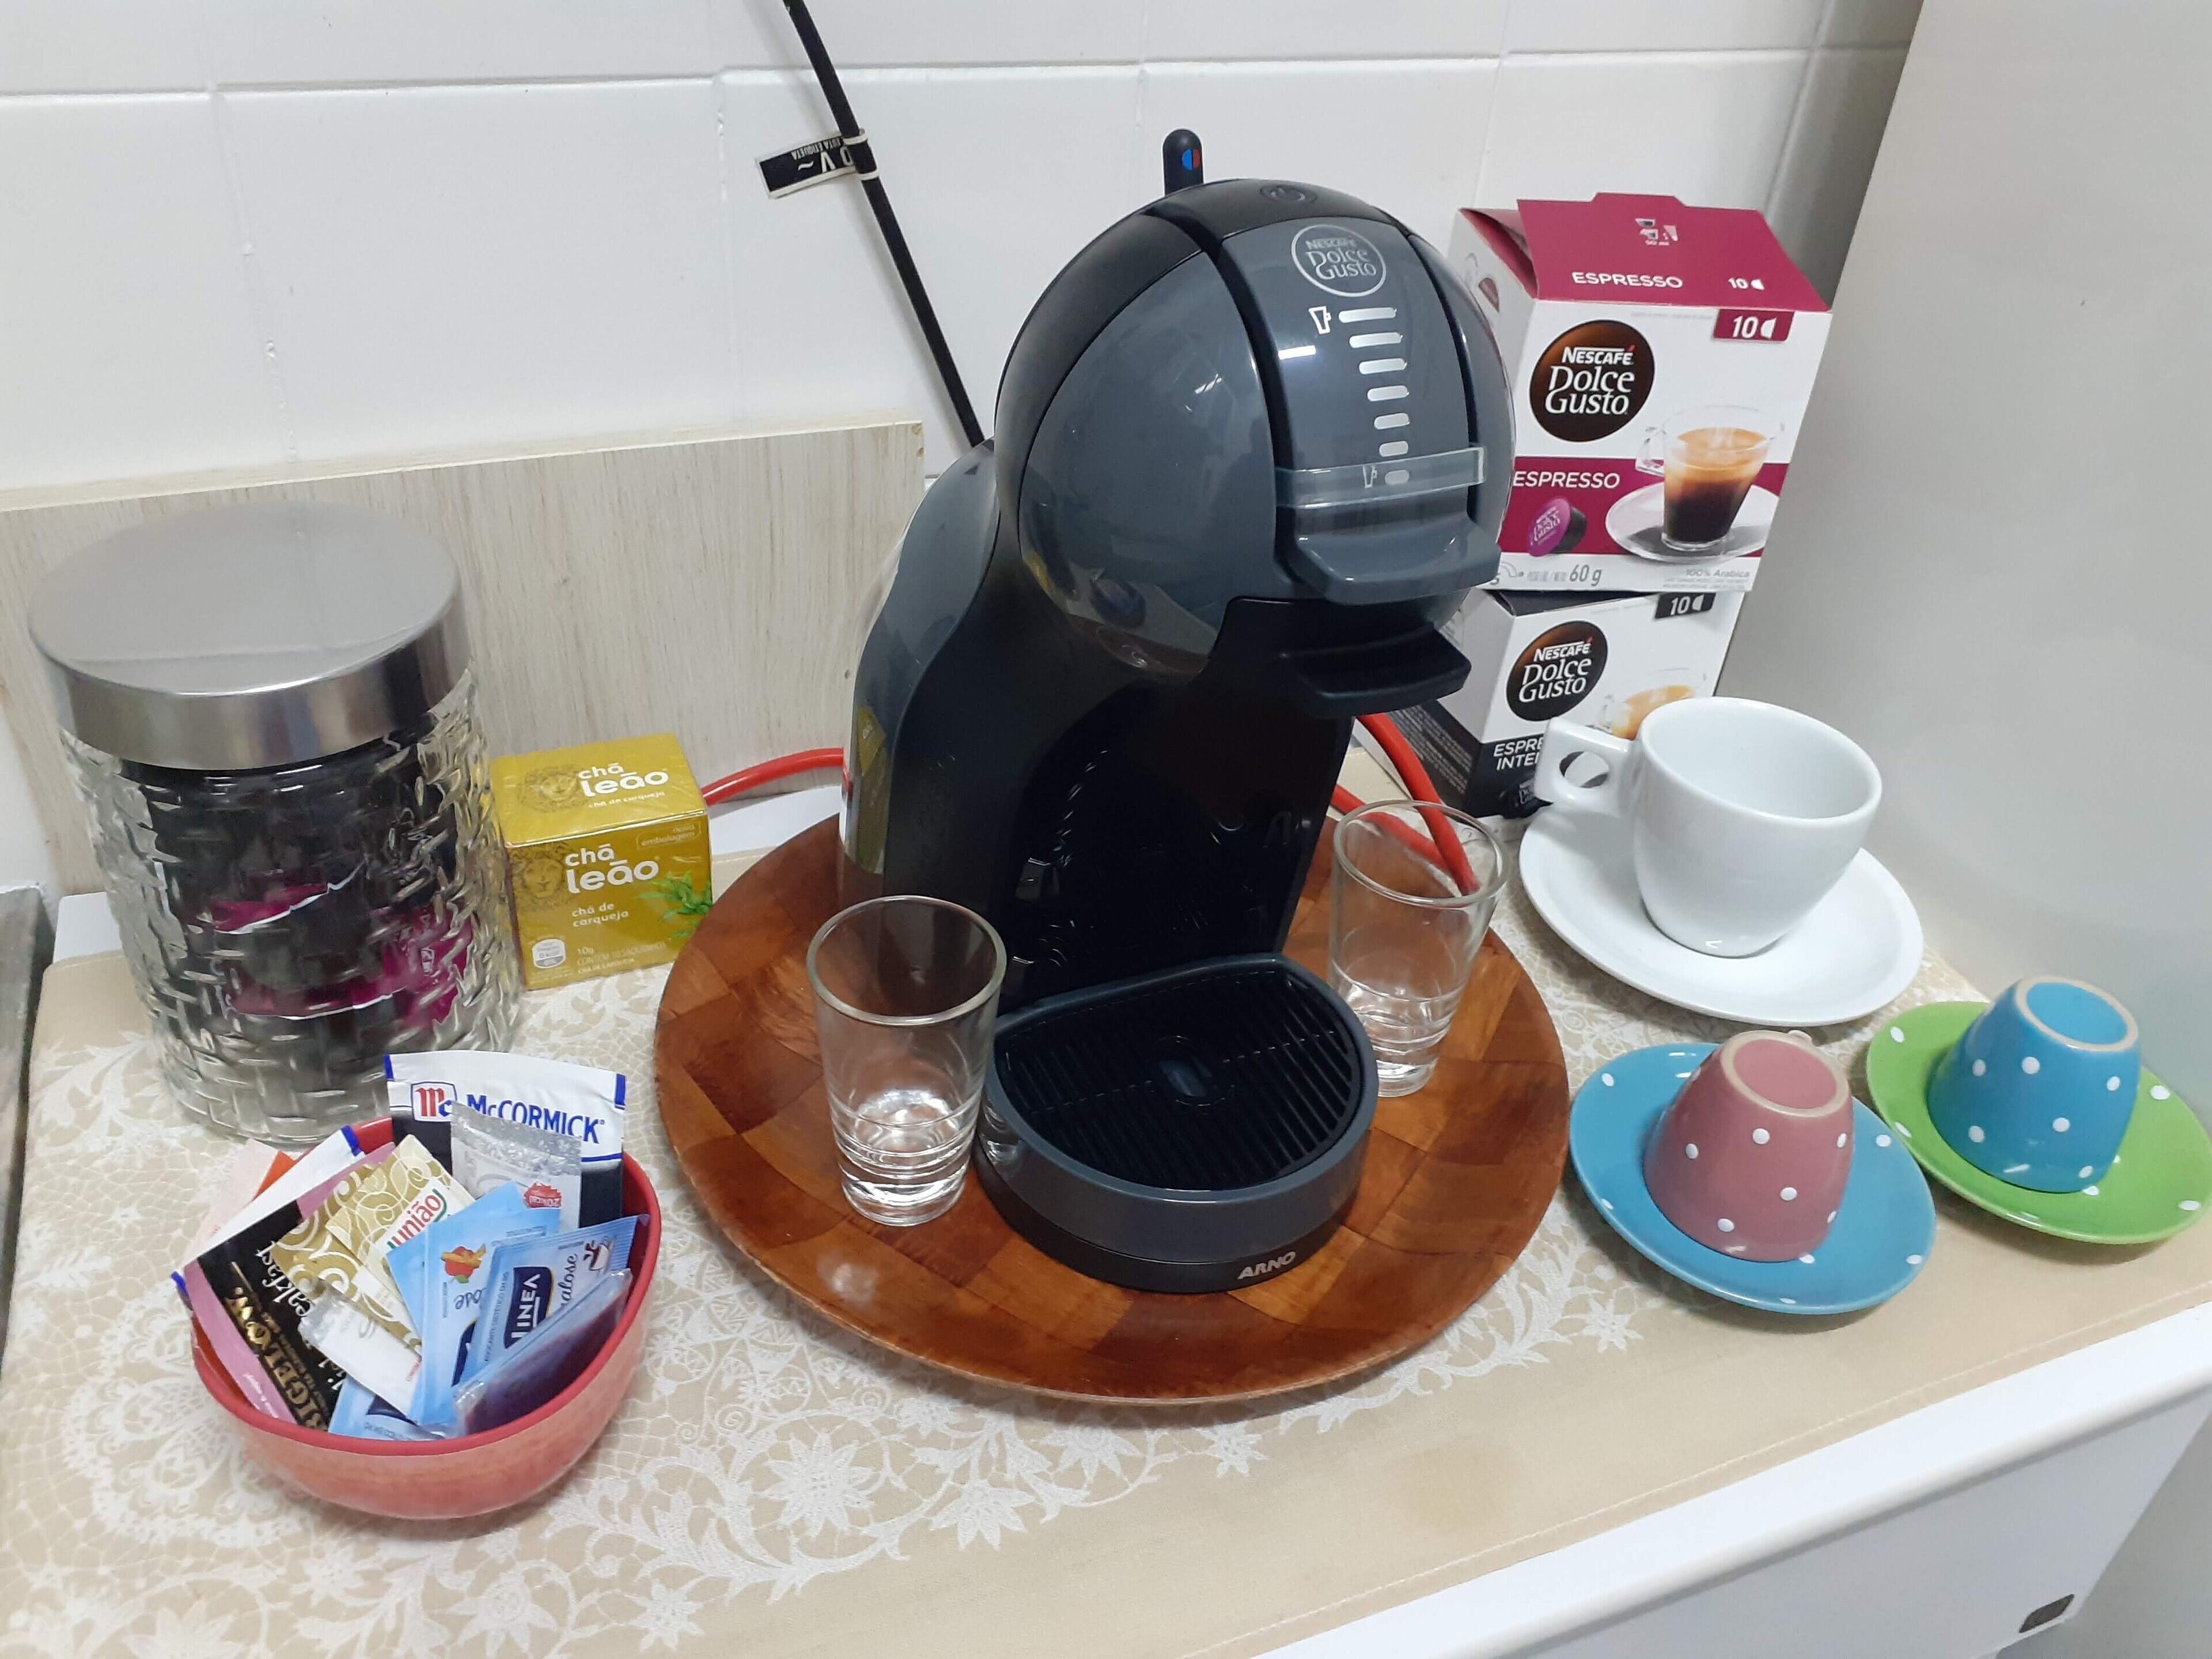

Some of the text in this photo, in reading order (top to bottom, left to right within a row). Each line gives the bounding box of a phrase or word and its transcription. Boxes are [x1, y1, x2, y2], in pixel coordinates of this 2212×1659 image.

[1305, 248, 1371, 267] Dolce
[1316, 260, 1377, 280] Gusto
[1571, 271, 1748, 289] ESPRESSO 10
[1732, 315, 1758, 339] 10
[1561, 344, 1635, 366] NESCAFÉ
[1548, 365, 1635, 393] Dolce
[1544, 387, 1630, 415] Gusto
[1513, 471, 1620, 490] ESPRESSO
[1670, 596, 1690, 616] 10
[1533, 637, 1593, 662] NESCAFÉ
[1522, 658, 1592, 685] Dolce
[1518, 677, 1587, 703] Gusto
[1493, 737, 1544, 757] ESPRE
[1496, 751, 1540, 771] INTE
[573, 909, 630, 927] carqueja
[599, 902, 615, 912] de
[1237, 1251, 1296, 1279] ARNO
[255, 1240, 313, 1319] eakfast
[558, 1253, 578, 1306] alose
